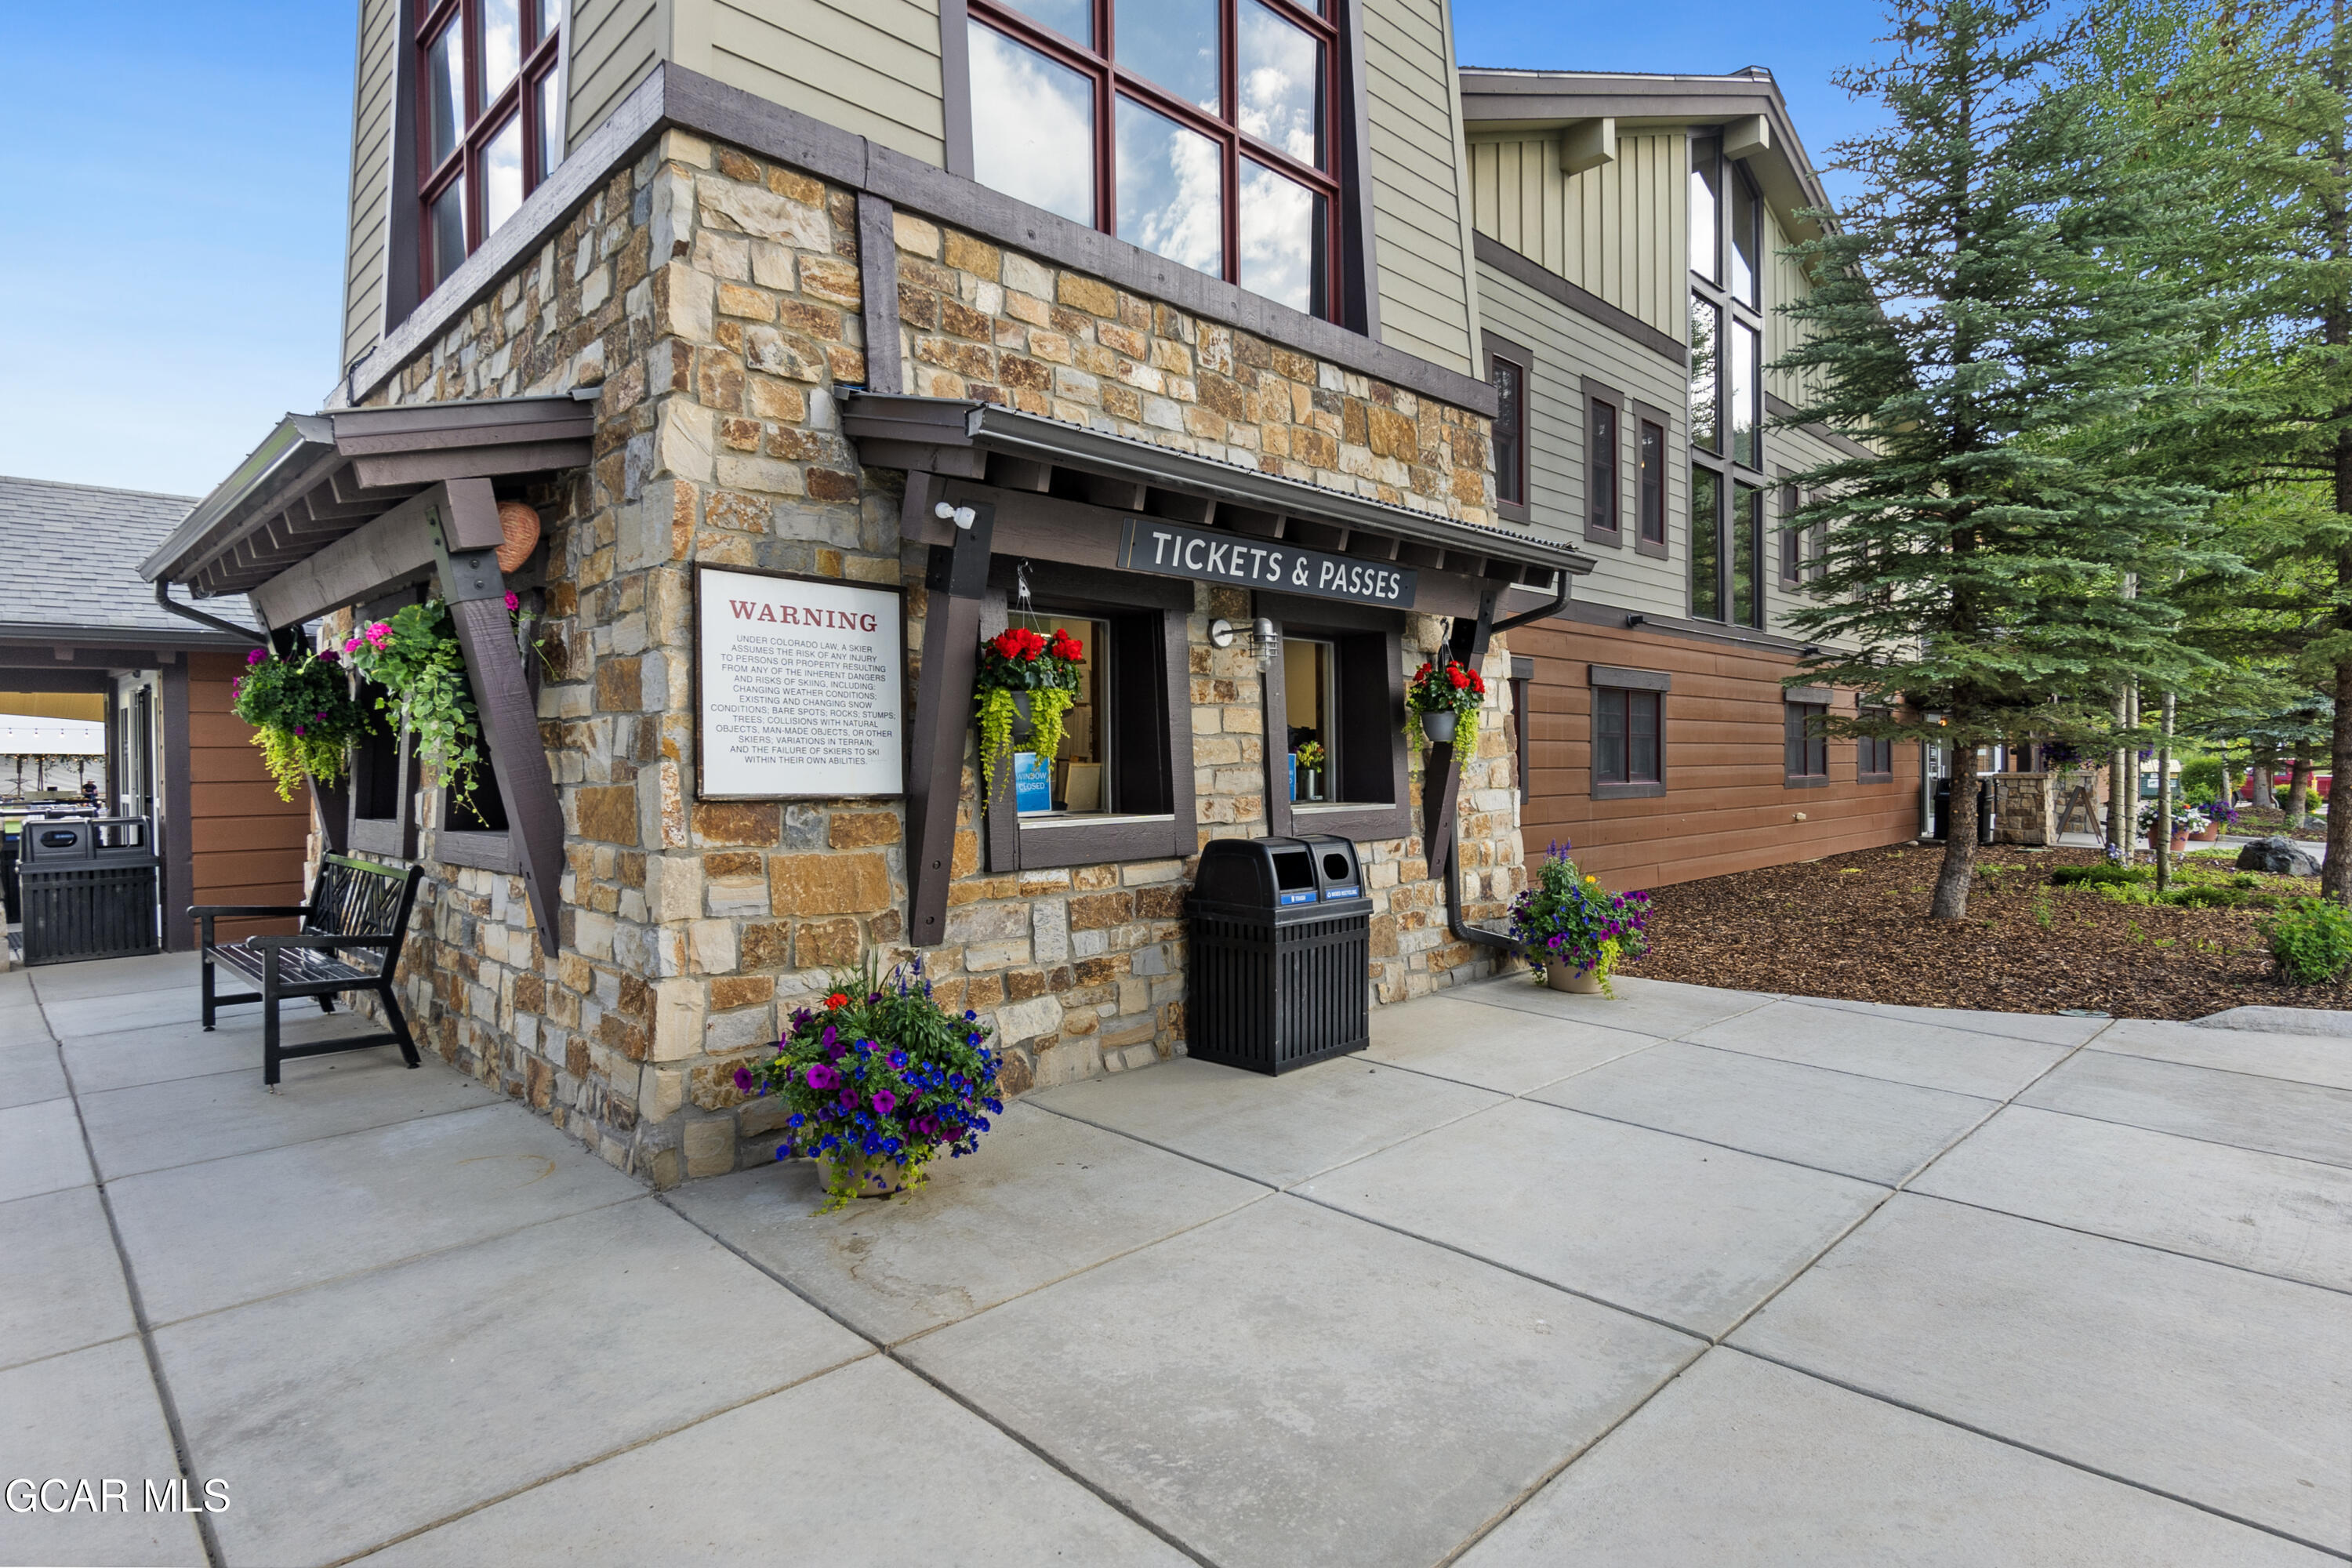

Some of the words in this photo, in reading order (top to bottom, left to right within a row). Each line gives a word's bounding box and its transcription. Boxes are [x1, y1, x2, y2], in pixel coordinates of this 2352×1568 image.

[1152, 532, 1283, 583] TICKETS
[1291, 557, 1308, 586] &
[1319, 561, 1401, 600] PASSES
[729, 600, 877, 633] WARNING
[736, 634, 768, 644] UNDER
[770, 637, 818, 648] COLORADO
[848, 644, 872, 652] SKIER
[731, 644, 774, 655] ASSUMES
[776, 647, 793, 656] THE
[796, 649, 815, 658] RISK
[849, 654, 877, 662] INJURY
[735, 654, 778, 665] PERSONS
[796, 659, 840, 669] PROPERTY
[842, 662, 886, 672] RESULTING
[721, 663, 747, 672] FROM
[804, 670, 845, 678] INHERENT
[848, 672, 885, 681] DANGERS
[733, 674, 753, 683] AND
[755, 676, 782, 684] RISKS
[732, 684, 780, 694] CHANGING
[782, 688, 823, 696] WEATHER
[739, 695, 780, 704] EXISTING
[802, 698, 846, 707] CHANGING
[767, 716, 818, 725] COLLISIONS
[842, 719, 878, 728] NATURAL
[762, 726, 808, 735] MAN-MADE
[775, 736, 826, 745] VARIATIONS
[750, 745, 768, 753] THE
[771, 746, 807, 754] FAILURE
[822, 746, 852, 755] SKIERS
[806, 756, 826, 765] OWN
